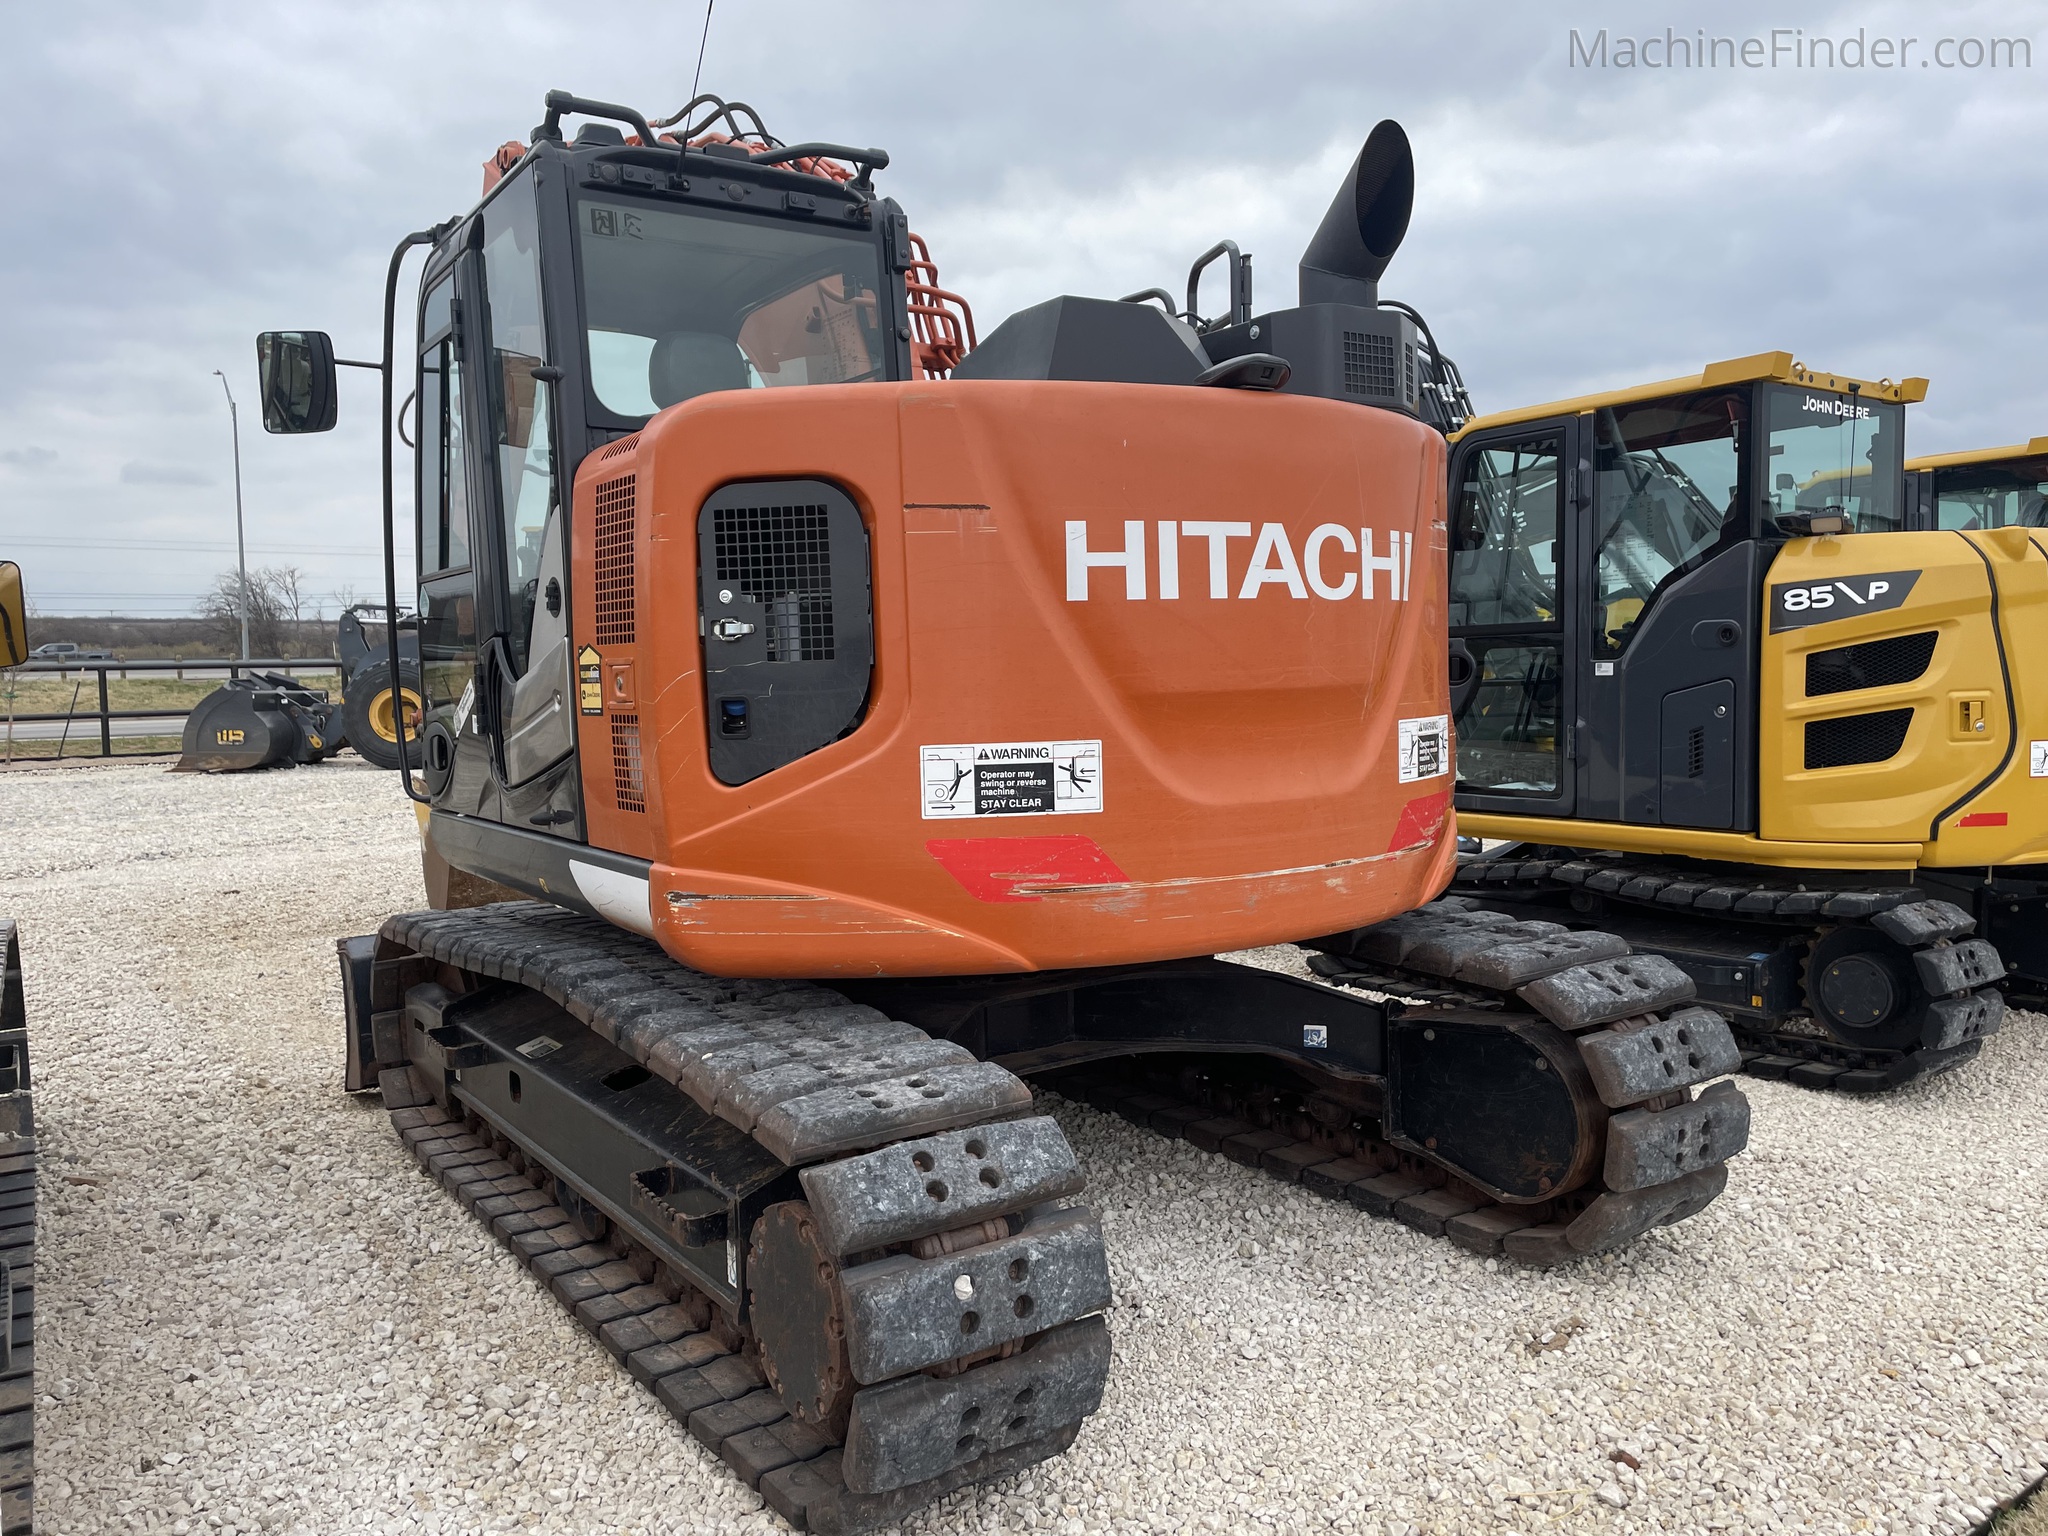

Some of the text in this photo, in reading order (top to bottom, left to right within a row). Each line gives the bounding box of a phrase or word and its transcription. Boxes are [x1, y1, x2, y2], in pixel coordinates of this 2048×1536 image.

[1802, 395, 1870, 419] JOHN DEERE
[1065, 520, 1412, 601] HITACHI
[990, 747, 1049, 759] WARNING
[980, 771, 1016, 780] Operator
[980, 780, 1005, 788] swing
[980, 788, 1015, 796] machine
[980, 798, 1042, 808] STAY CLEAR
